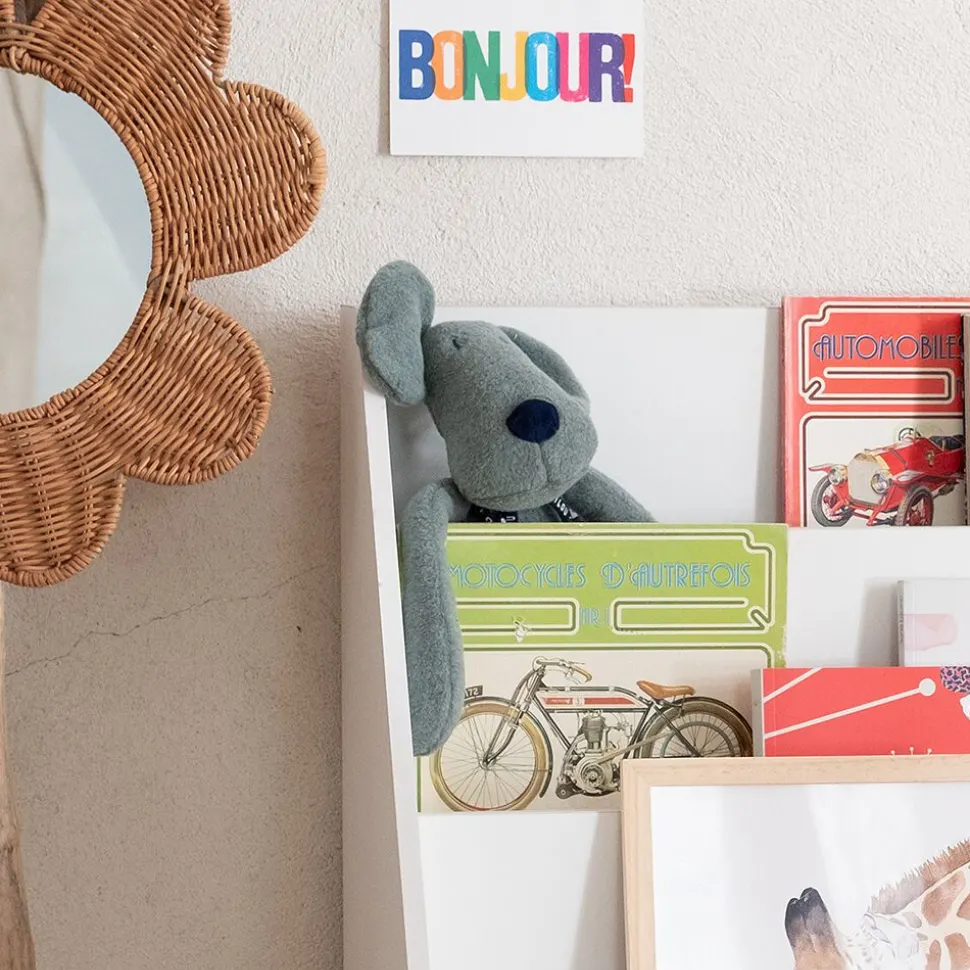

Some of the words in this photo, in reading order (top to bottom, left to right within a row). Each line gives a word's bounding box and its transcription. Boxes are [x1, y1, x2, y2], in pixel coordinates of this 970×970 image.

[398, 29, 636, 103] BONJOUR!
[450, 562, 587, 589] MOTOCYCLES
[600, 560, 752, 591] D'AUTREFOIS
